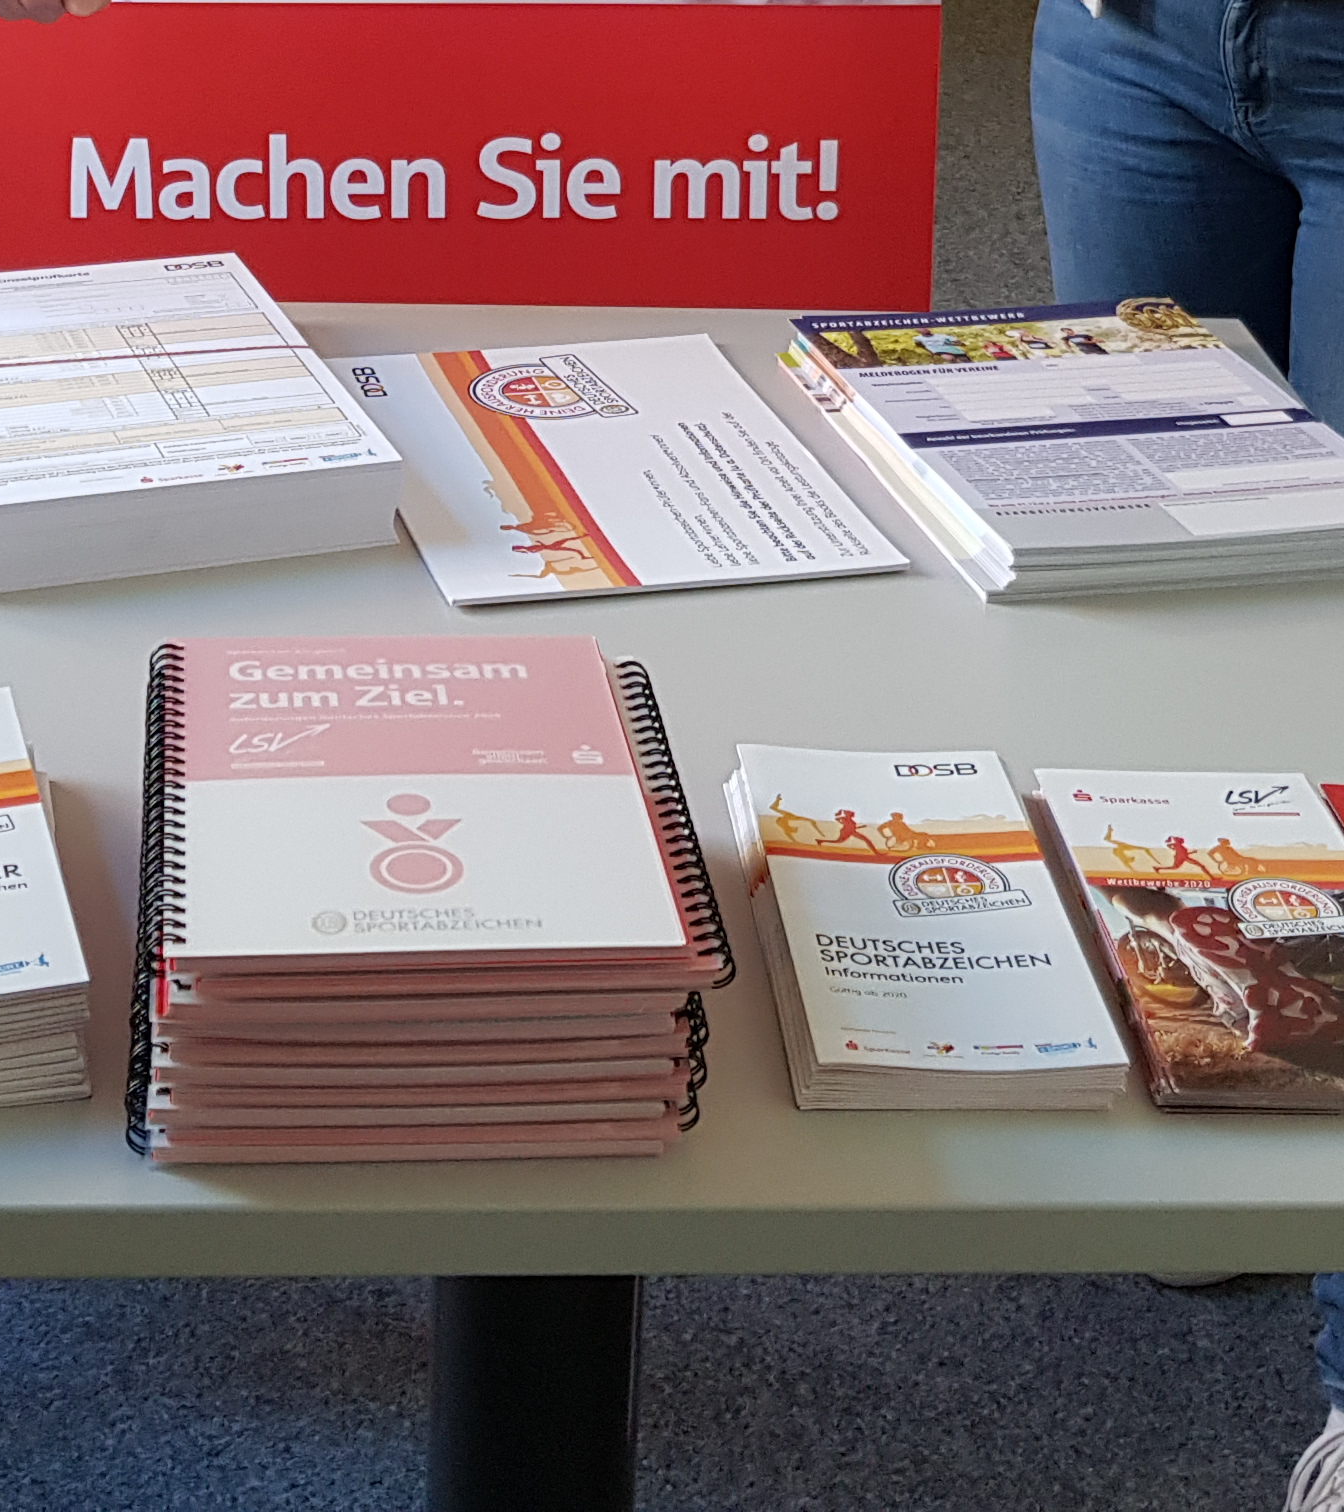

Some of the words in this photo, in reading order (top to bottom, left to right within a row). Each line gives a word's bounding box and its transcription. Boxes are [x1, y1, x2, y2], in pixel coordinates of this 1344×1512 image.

[68, 132, 447, 221] Machen
[476, 131, 619, 221] Sie
[653, 132, 841, 223] mit!
[163, 259, 225, 272] DOSB
[859, 369, 931, 378] MELDEBOGEN
[932, 367, 954, 375] FÜR
[955, 365, 1000, 374] VEREINE
[481, 368, 545, 416] HERAUSFORDERUNG
[563, 374, 606, 406] DEUTSCHES
[676, 421, 714, 460] Informationen
[713, 472, 745, 499] Hinweise
[736, 499, 753, 509] die
[745, 509, 761, 519] Sie
[752, 518, 786, 547] beachten
[228, 659, 528, 682] Gemeinsam
[228, 689, 340, 711] zum
[354, 684, 464, 710] Ziel.
[227, 725, 307, 754] LSV
[893, 762, 979, 778] DOSB
[1099, 794, 1171, 806] Sparkasse
[1224, 785, 1280, 806] LSV
[904, 858, 1000, 890] HERAUSFORDERUNG
[1106, 878, 1180, 889] Wettbewerbe
[1183, 879, 1212, 889] 2020
[921, 896, 988, 908] DEUTSCHES
[1240, 881, 1334, 915] HERAUSFORDERUNG
[352, 908, 475, 923] DEUTSCHES
[352, 918, 543, 933] SPORTABZEICHEN
[815, 933, 966, 955] DEUTSCHES
[820, 949, 1052, 971] SPORTABZEICHEN
[824, 965, 964, 984] Informationen
